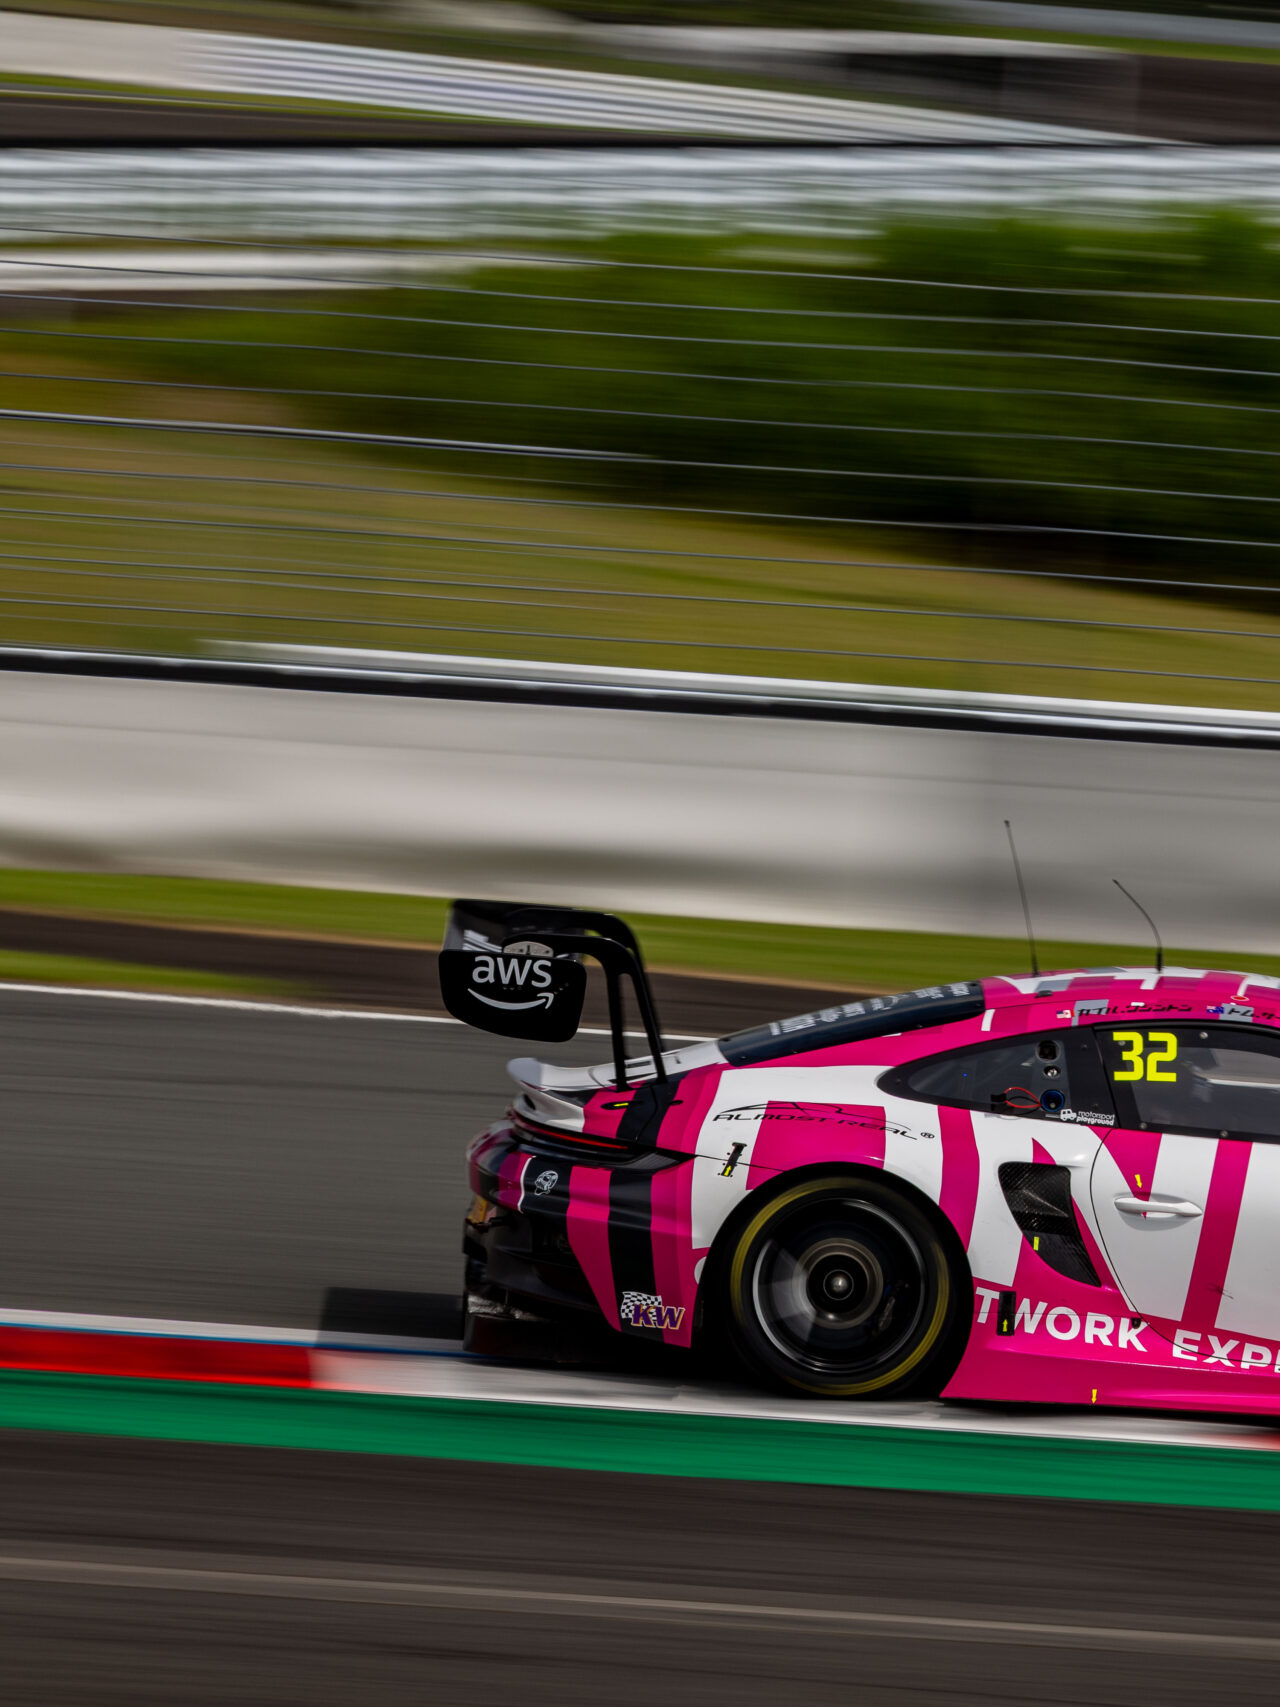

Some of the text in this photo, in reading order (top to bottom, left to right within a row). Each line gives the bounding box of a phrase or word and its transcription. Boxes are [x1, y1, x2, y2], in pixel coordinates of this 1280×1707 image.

[471, 955, 552, 988] aws
[1113, 1031, 1178, 1082] 32
[712, 1113, 918, 1140] ALMOST REAL
[1076, 1116, 1115, 1126] playground
[1078, 1111, 1115, 1120] motorsport
[631, 1303, 686, 1330] KW
